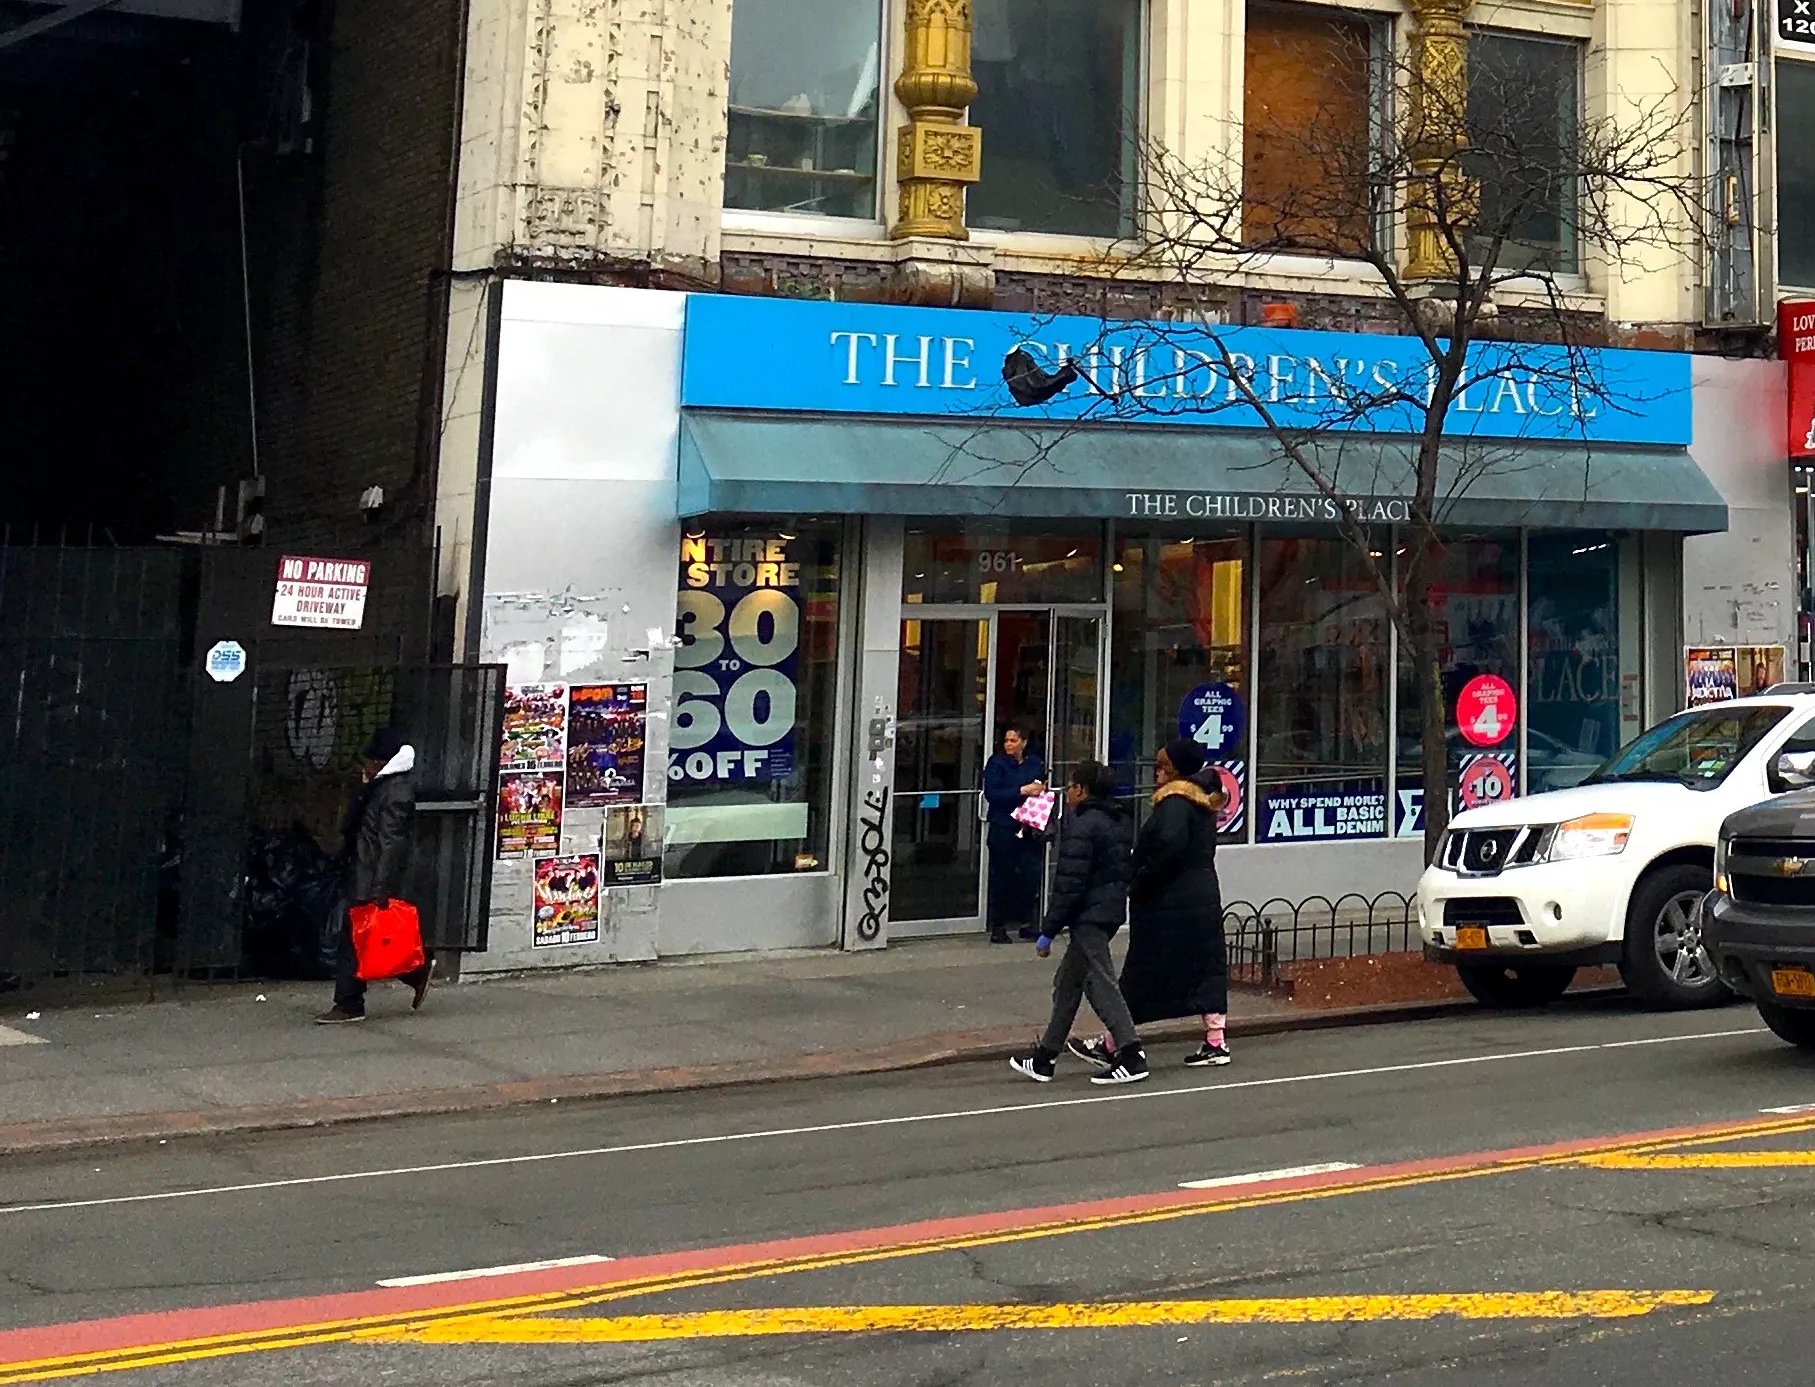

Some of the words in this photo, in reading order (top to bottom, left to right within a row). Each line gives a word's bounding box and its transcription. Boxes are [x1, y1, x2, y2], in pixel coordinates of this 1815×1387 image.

[830, 331, 977, 390] THE
[1126, 493, 1178, 516] THE
[1185, 495, 1337, 520] CHILDREN'S
[681, 539, 786, 562] NTIRE
[282, 559, 304, 579] NO
[307, 561, 367, 584] PARKING
[977, 552, 1017, 573] 961
[686, 563, 800, 587] STORE
[280, 584, 294, 597] 24
[298, 585, 325, 599] HOUR
[328, 587, 362, 601] ACTIVE
[296, 600, 347, 615] DRIVEWAY
[675, 588, 800, 667] 30
[719, 659, 741, 671] TO
[1193, 698, 1232, 706] GRAPHIC
[1204, 690, 1222, 698] ALL
[668, 668, 797, 749] 60
[1202, 706, 1224, 714] TEES
[1268, 798, 1299, 810] WHY
[1299, 796, 1342, 809] SPEND
[1344, 794, 1386, 807] MORE?
[1336, 806, 1385, 821] BASIC
[1267, 808, 1336, 839] ALL
[1336, 819, 1385, 835] DENIM
